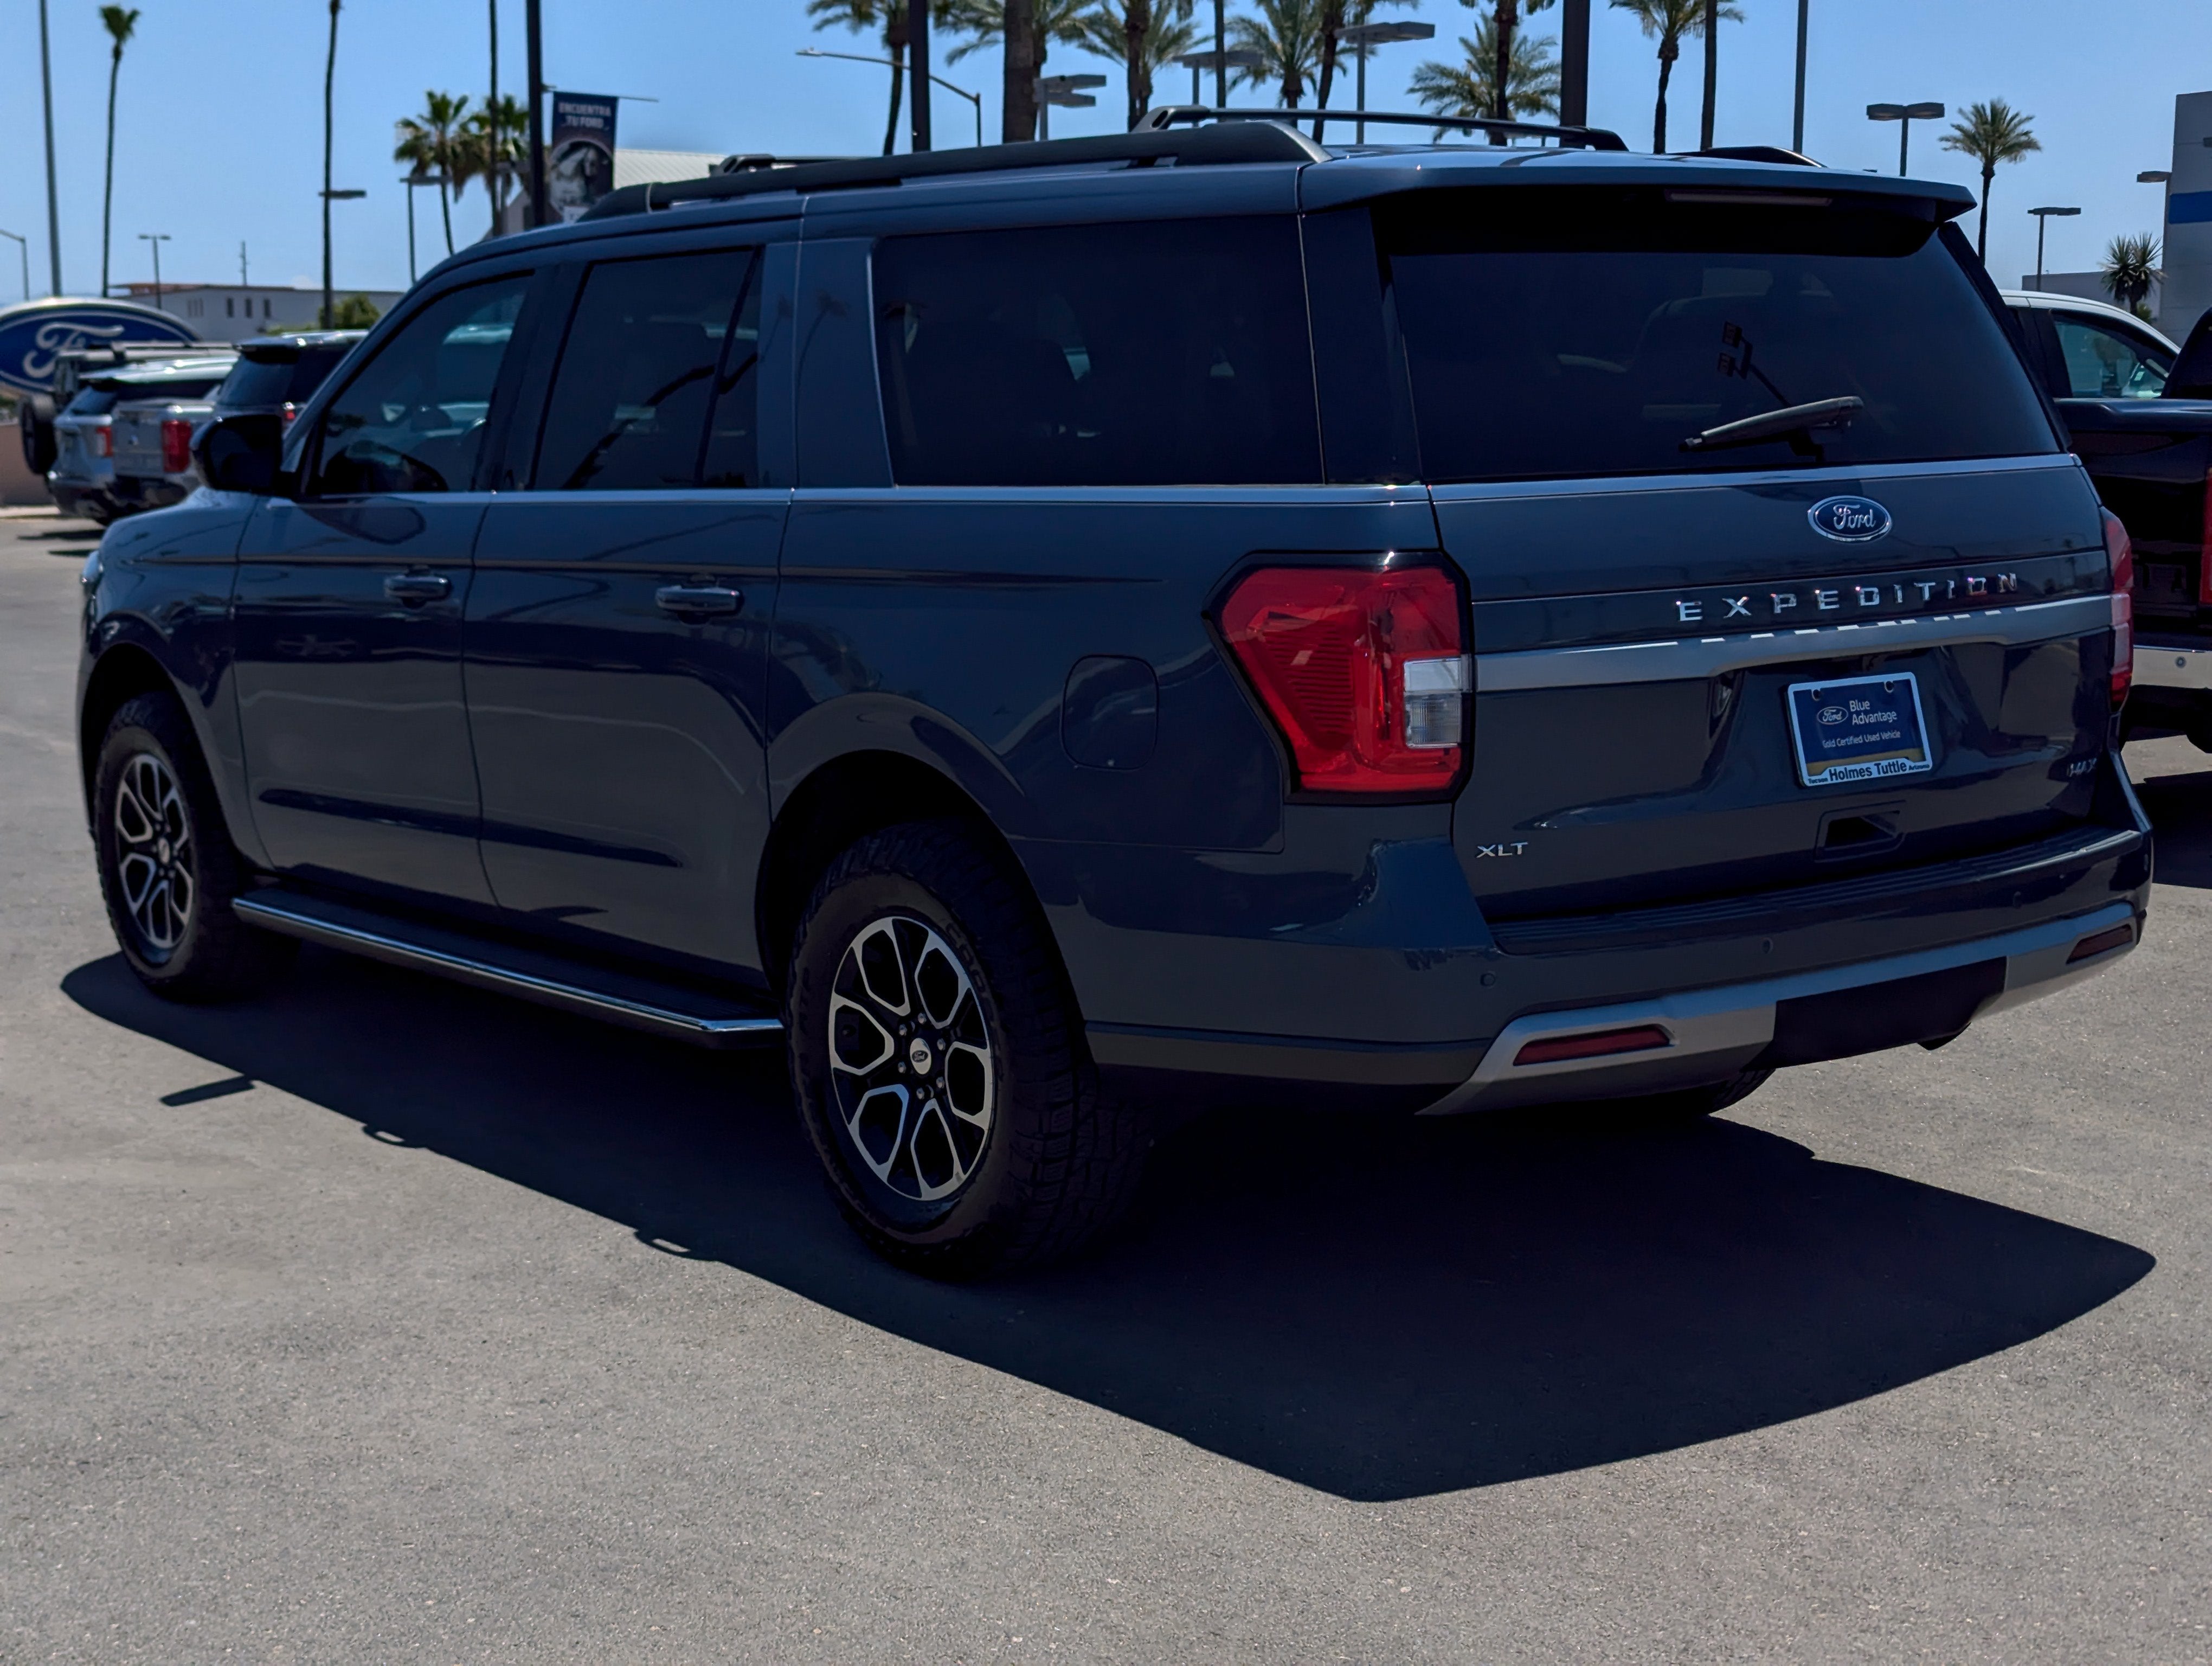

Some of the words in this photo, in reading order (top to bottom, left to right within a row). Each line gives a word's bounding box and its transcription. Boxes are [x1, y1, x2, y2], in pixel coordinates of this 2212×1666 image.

[1832, 503, 1876, 529] Ford
[1676, 572, 2017, 622] EXPEDITION
[1849, 699, 1870, 712] Blue
[1822, 709, 1843, 722] Ford
[1852, 710, 1898, 726] Advantage
[1822, 739, 1836, 748] Gold
[1836, 735, 1863, 747] Certified
[1864, 732, 1880, 742] Used
[1880, 730, 1901, 740] Vehicle
[1829, 765, 1873, 781] Holmes
[1874, 760, 1907, 775] Tuttle
[1476, 842, 1528, 858] XLT
